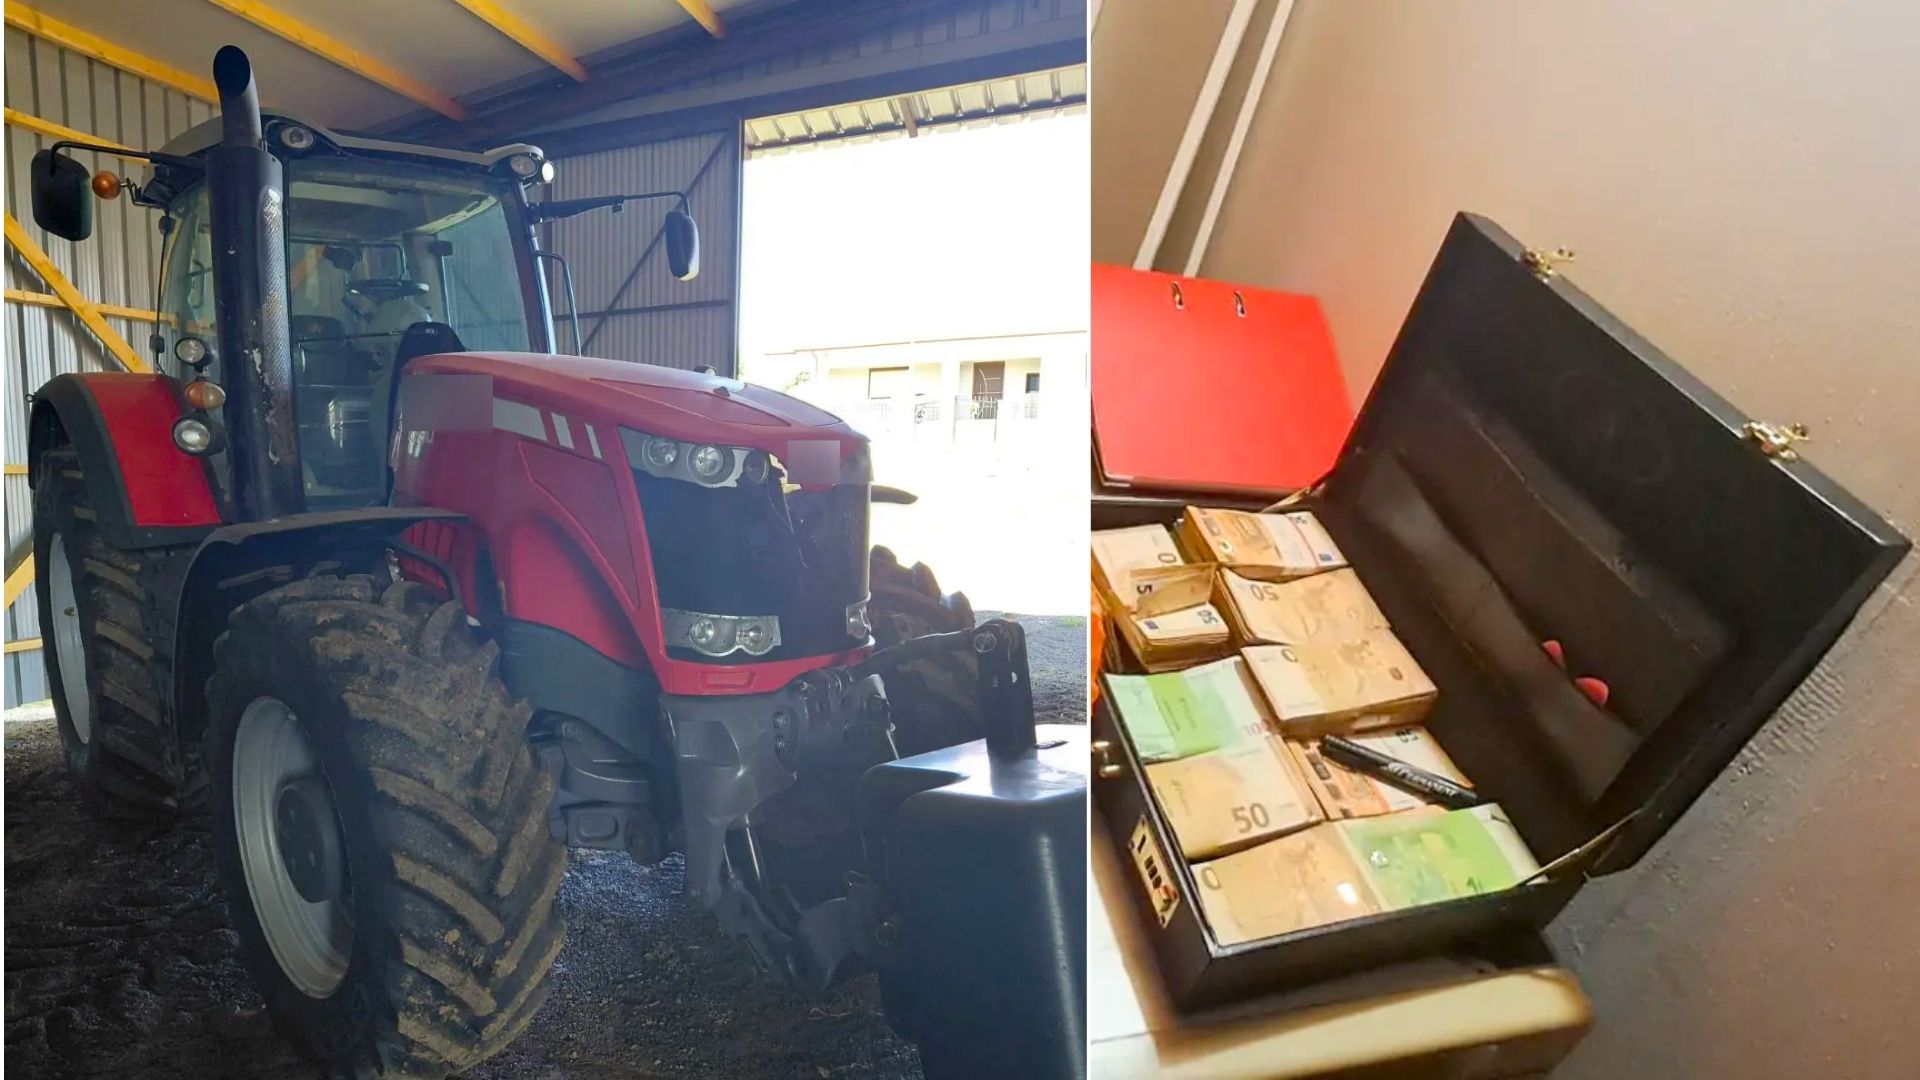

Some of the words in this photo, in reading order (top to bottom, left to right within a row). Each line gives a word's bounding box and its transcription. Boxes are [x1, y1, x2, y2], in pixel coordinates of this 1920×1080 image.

[1249, 583, 1280, 602] 50
[1197, 609, 1219, 624] 50
[1231, 802, 1271, 834] 50
